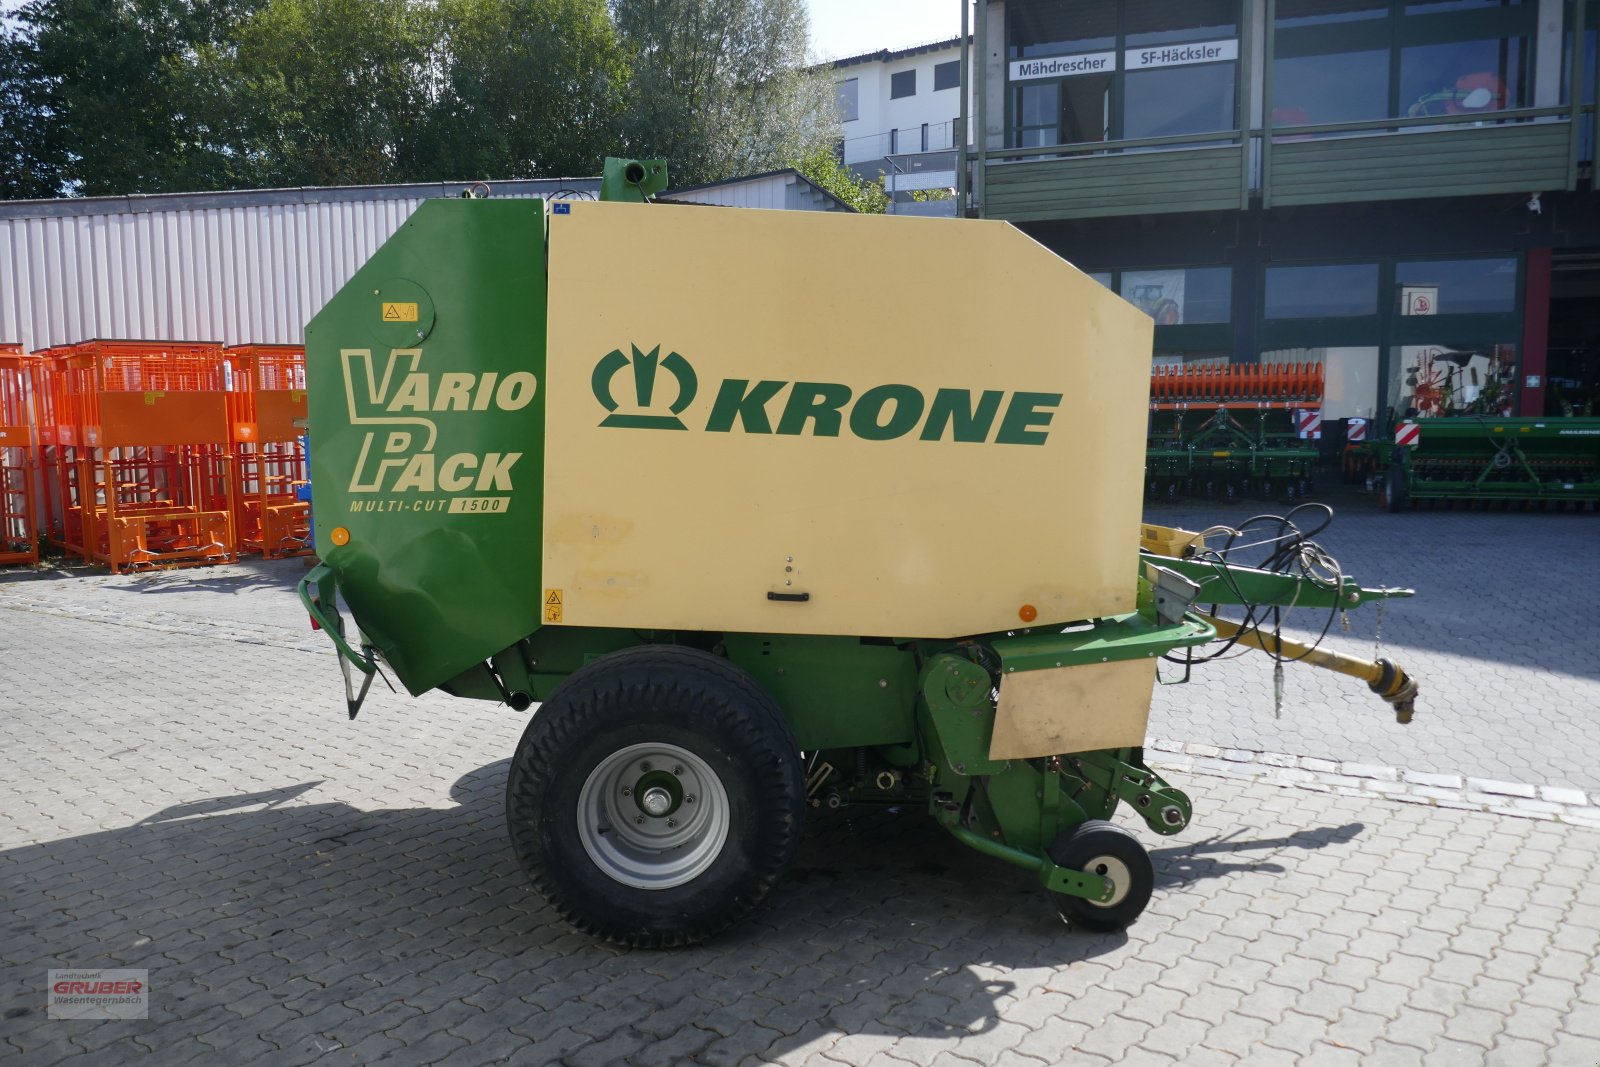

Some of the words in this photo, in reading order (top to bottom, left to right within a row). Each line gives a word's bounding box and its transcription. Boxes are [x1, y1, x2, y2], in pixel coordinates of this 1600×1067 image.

[1019, 57, 1107, 77] Mähdrescher
[1140, 45, 1222, 65] SF-Häcksler
[340, 348, 537, 412] VARIO
[705, 378, 1064, 446] KRONE
[347, 431, 523, 492] PACK
[350, 500, 447, 512] MULTI-CUT
[460, 499, 500, 511] 1500
